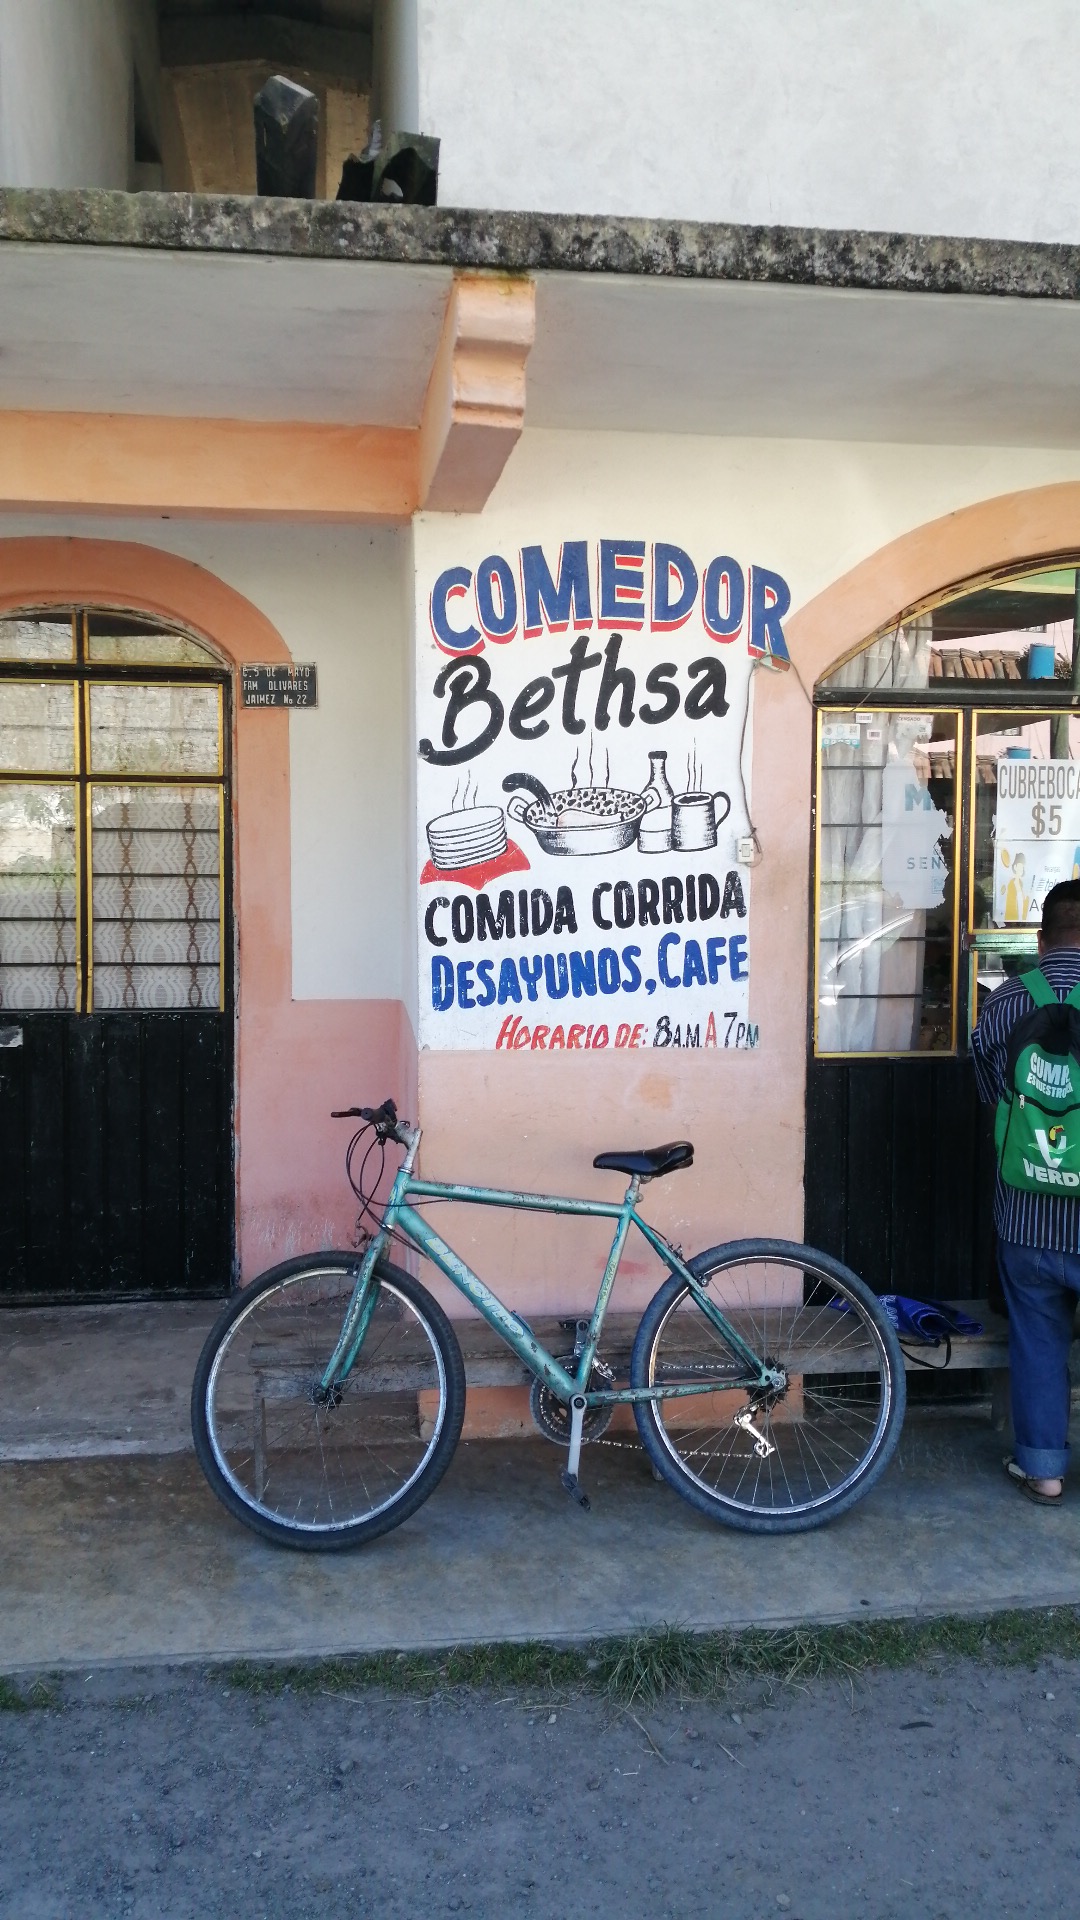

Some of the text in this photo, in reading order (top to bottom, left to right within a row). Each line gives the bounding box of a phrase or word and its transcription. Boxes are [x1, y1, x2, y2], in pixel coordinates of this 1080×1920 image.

[429, 539, 791, 661] COMEDOR
[243, 680, 308, 691] FAM OLIVARES
[287, 667, 310, 677] MAYO
[245, 694, 276, 705] JAIMEZ
[296, 694, 307, 705] 22
[418, 633, 730, 766] Bethsa
[1031, 801, 1063, 838] $5
[424, 871, 747, 947] COMIDA CORRIDA
[658, 932, 748, 988] CAFE
[496, 1014, 609, 1049] HORARIO
[615, 1023, 649, 1049] DE:
[705, 1011, 717, 1048] A
[1022, 1157, 1080, 1187] VERD
